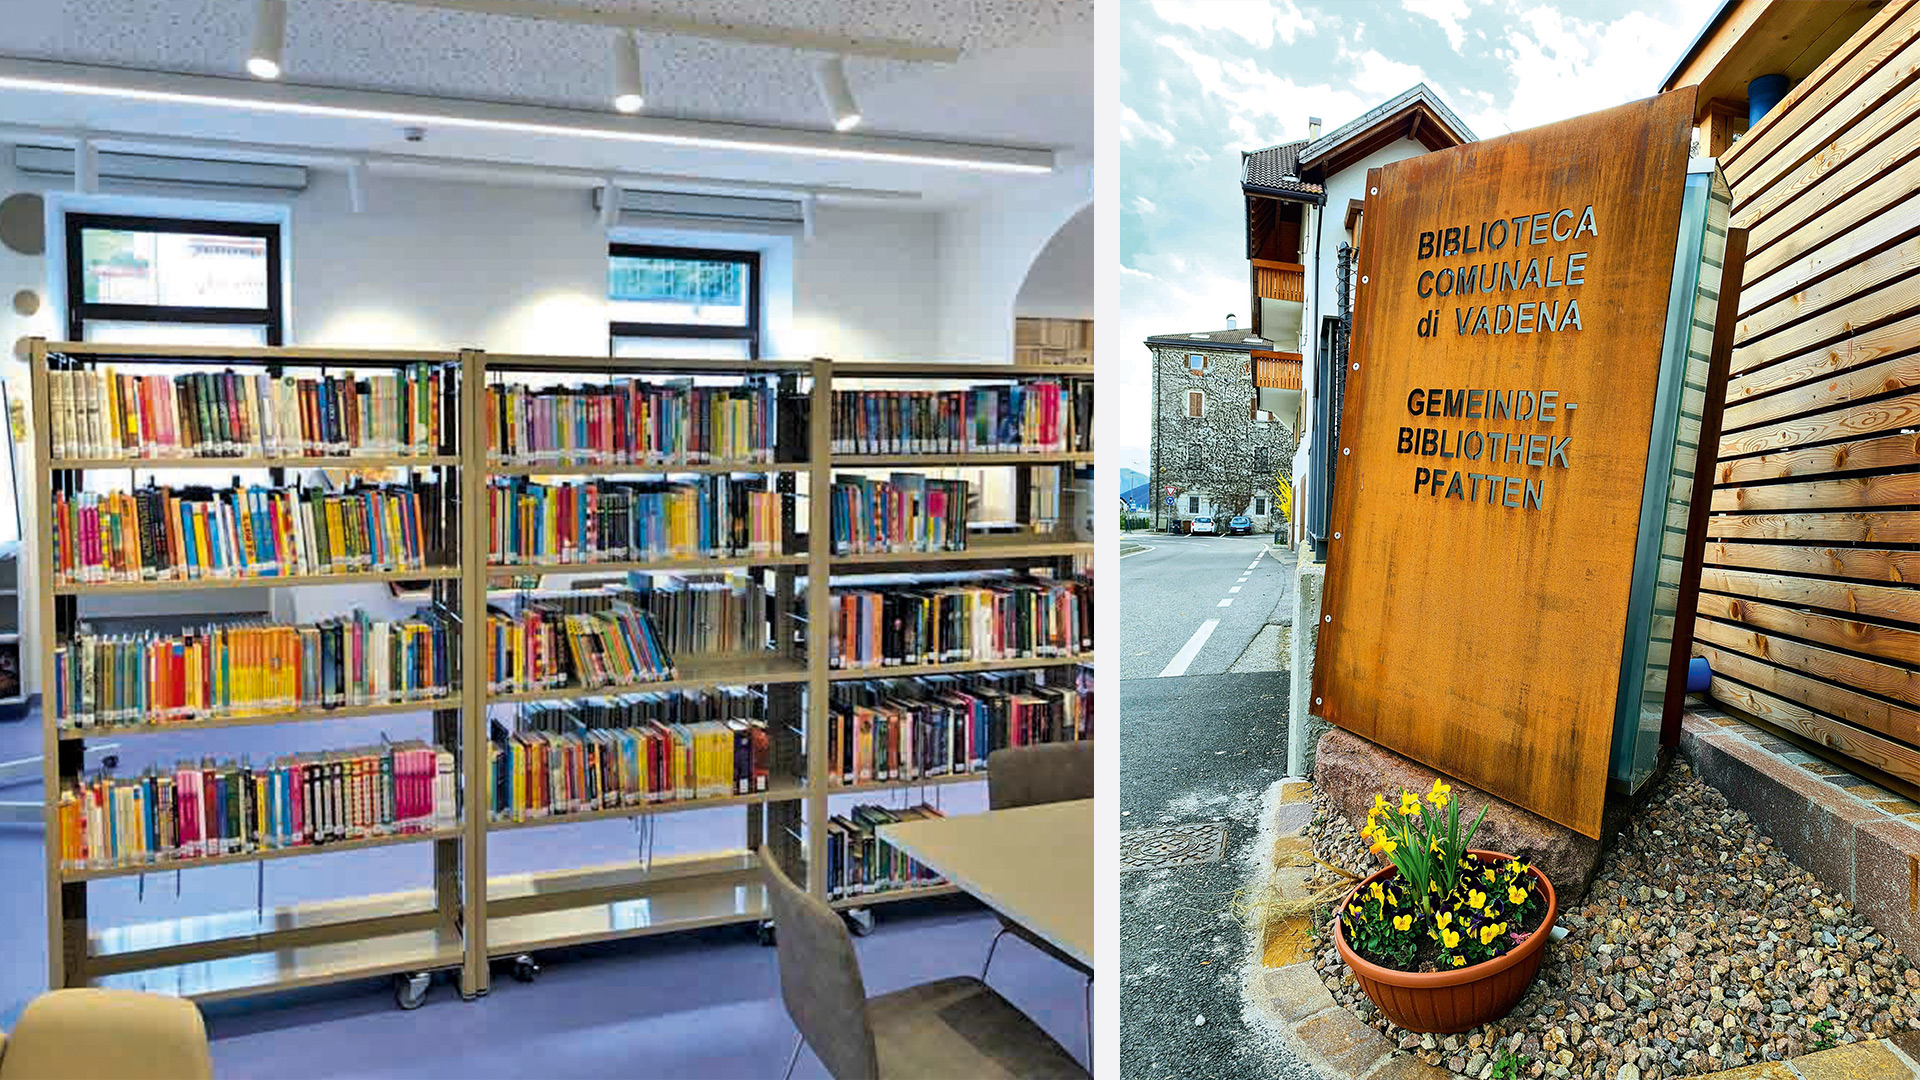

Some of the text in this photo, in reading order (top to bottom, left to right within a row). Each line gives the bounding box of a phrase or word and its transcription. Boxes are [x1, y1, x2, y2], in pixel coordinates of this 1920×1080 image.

[1417, 205, 1598, 260] BIBLIOTECA
[1417, 252, 1588, 299] COMUNALE
[1417, 299, 1583, 338] di VADENA
[1407, 388, 1578, 422] GEMEINDE-
[1397, 427, 1573, 469] BIBLIOTHEK
[1413, 467, 1545, 511] PFATTEN
